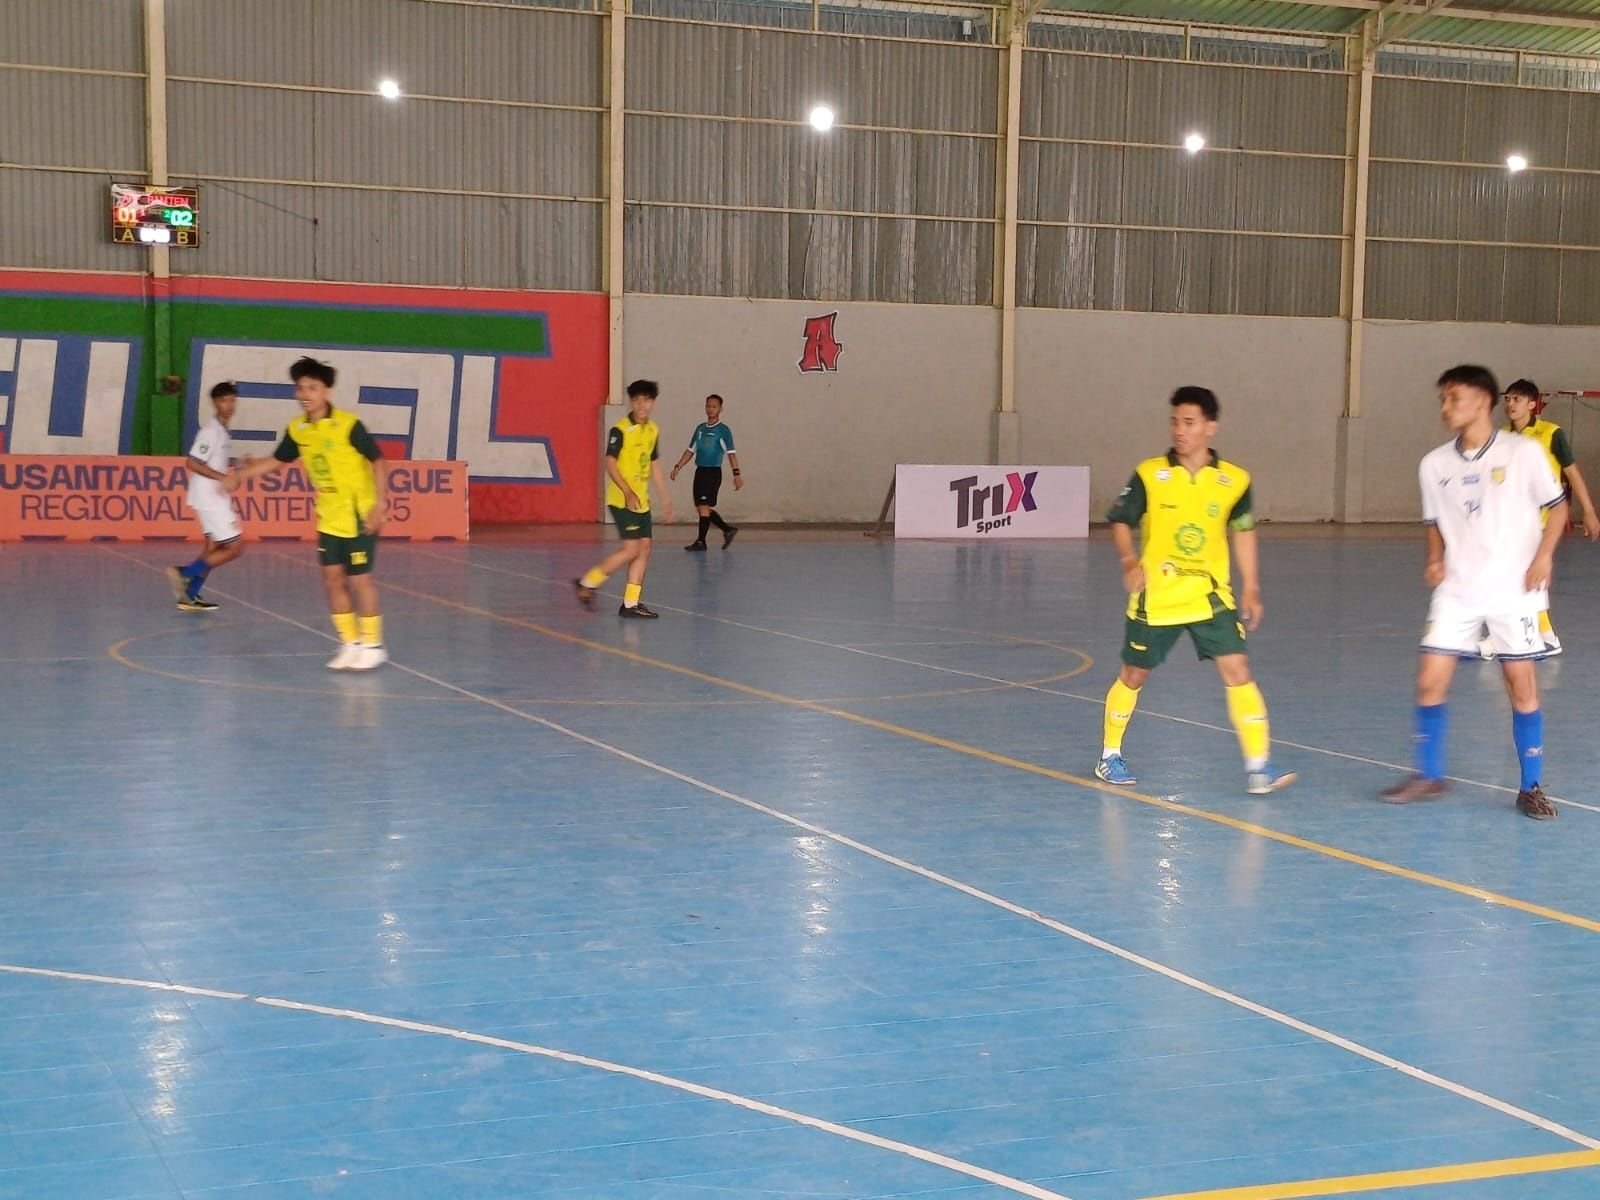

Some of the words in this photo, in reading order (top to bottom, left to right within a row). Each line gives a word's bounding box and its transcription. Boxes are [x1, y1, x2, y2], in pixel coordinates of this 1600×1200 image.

[170, 210, 193, 226] 02
[122, 228, 135, 241] A
[177, 231, 189, 244] B
[388, 468, 454, 494] GUE
[20, 494, 195, 521] REGIONAL
[231, 496, 315, 522] ANTE
[976, 515, 1012, 534] Sport
